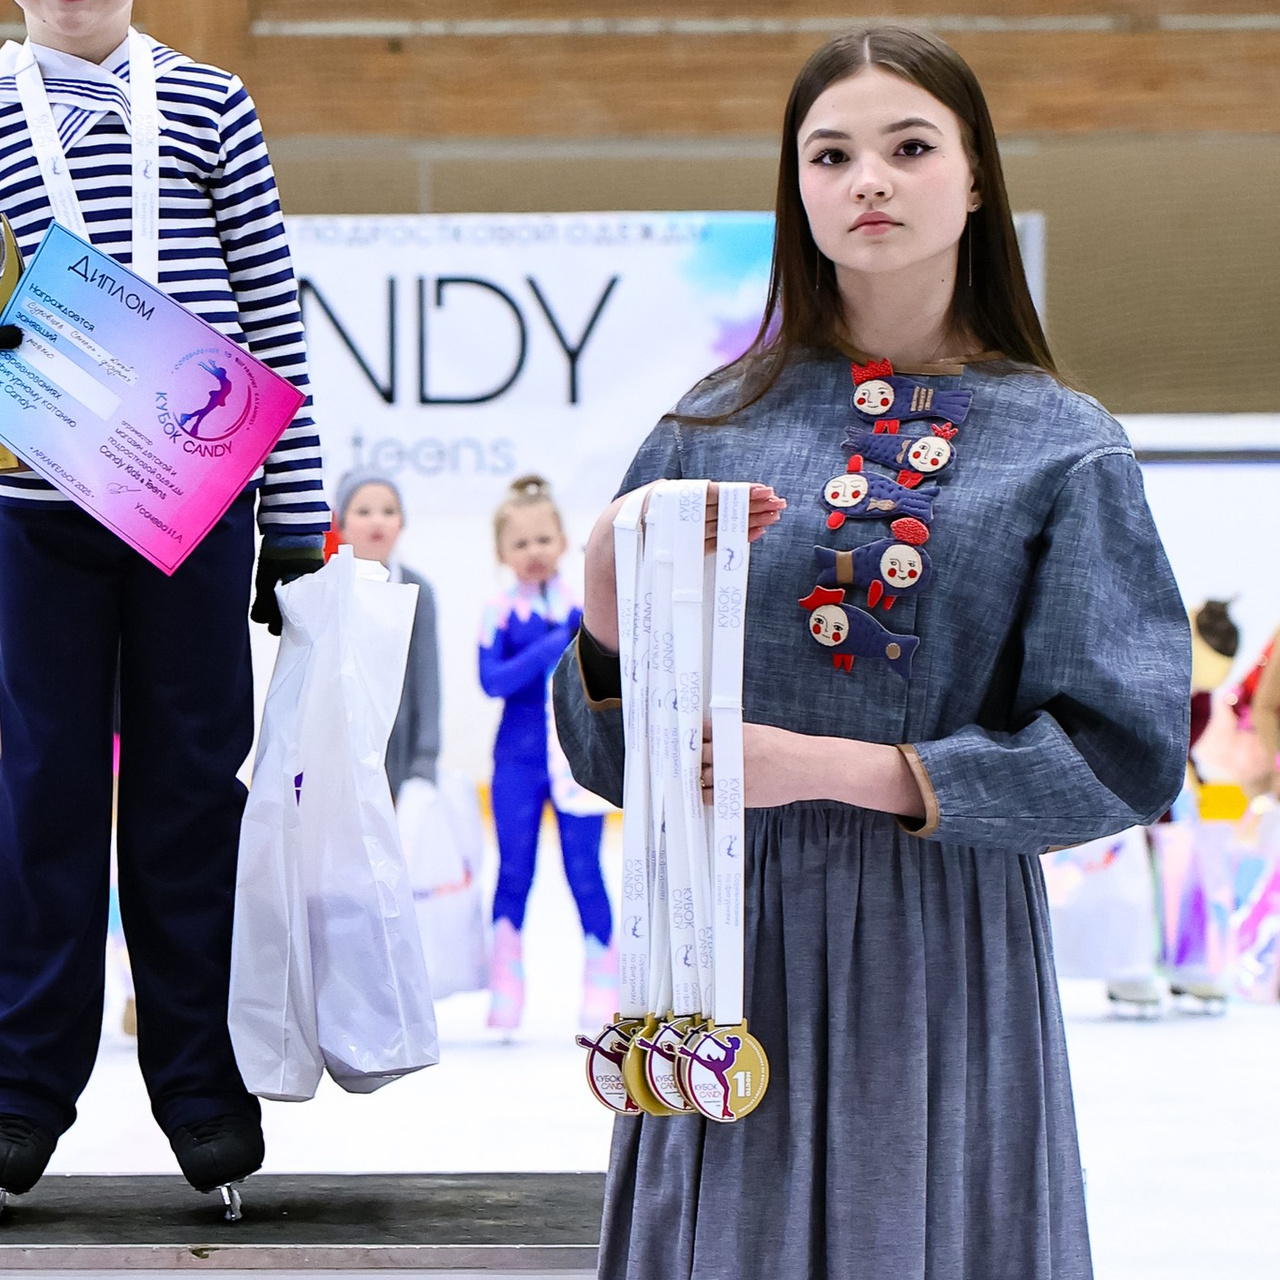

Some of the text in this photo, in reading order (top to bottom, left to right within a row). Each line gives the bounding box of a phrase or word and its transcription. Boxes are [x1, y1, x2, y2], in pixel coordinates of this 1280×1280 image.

[15, 310, 58, 343] занявший
[28, 283, 95, 333] Награждается
[300, 276, 620, 405] NDY
[41, 399, 77, 428] катанию
[155, 391, 182, 444] КУБОК
[107, 436, 184, 496] подростковой одежды
[115, 428, 143, 451] магазин
[141, 448, 172, 472] детской
[183, 440, 232, 458] CANDY
[349, 430, 515, 475] teens
[32, 448, 92, 497] АРХАНГЕЛЬСК 2025
[99, 445, 126, 469] Candy
[126, 464, 142, 480] Kids
[143, 478, 168, 500] Teens
[680, 486, 691, 522] КУБО
[691, 486, 703, 523] CAND
[718, 585, 731, 629] КУБОК
[730, 586, 743, 629] CANDY
[662, 632, 673, 674] CANDY
[679, 672, 690, 714] CANDY
[689, 671, 700, 713] КУБОК
[717, 778, 729, 821] CANDY
[729, 778, 741, 820] КУБОК
[624, 859, 633, 901] CANDY
[634, 859, 644, 900] КУБОК
[672, 888, 684, 930] CANDY
[683, 887, 695, 929] КУБОК
[601, 1082, 625, 1090] CAND
[655, 1074, 674, 1082] КУБО
[732, 1071, 746, 1097] 1
